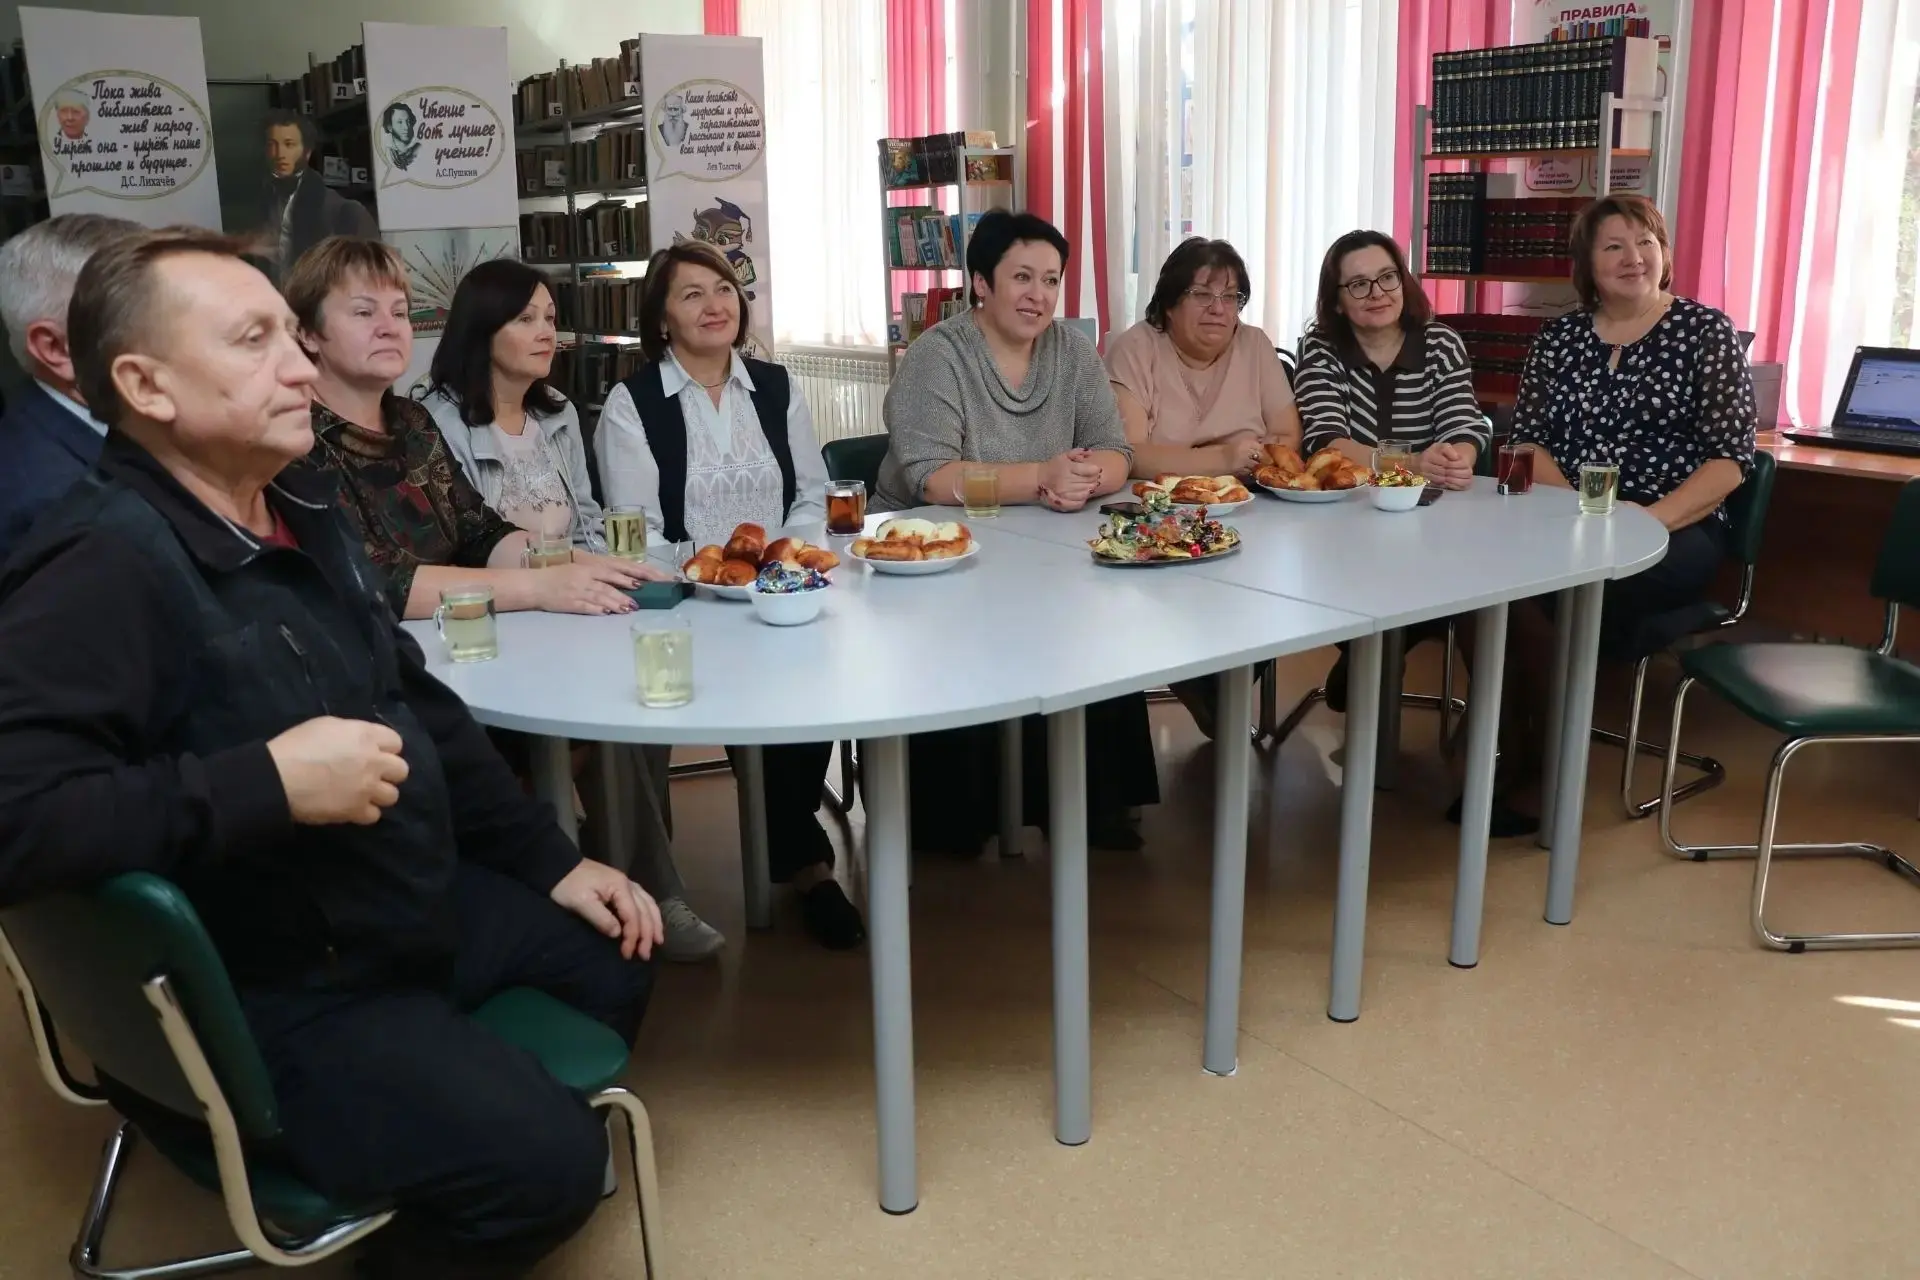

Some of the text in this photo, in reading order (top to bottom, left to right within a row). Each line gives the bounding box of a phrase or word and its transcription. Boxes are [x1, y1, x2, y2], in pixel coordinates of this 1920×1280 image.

[1560, 2, 1637, 21] ПРАВИЛА
[92, 80, 161, 100] Пока жива
[629, 85, 638, 95] А
[685, 89, 738, 104] Какое богатство
[98, 101, 172, 118] библиотека
[419, 97, 465, 119] Чтение
[553, 106, 562, 115] Б
[691, 105, 724, 120] мудрости
[734, 102, 753, 118] добра
[120, 119, 148, 134] жив
[417, 122, 496, 144] вот лучшее
[699, 118, 760, 132] заразительного
[688, 132, 725, 145] рассыпано
[737, 130, 761, 139] книгам
[54, 137, 92, 160] Умрёт
[97, 142, 118, 154] она
[133, 136, 169, 157] умрёт
[173, 138, 201, 150] наше
[435, 138, 493, 165] учение!
[680, 144, 694, 155] всех
[697, 141, 725, 157] народов
[71, 155, 192, 177] прошлое и будущее.
[707, 162, 742, 171] Лев Толстой
[121, 176, 176, 188] Д.С. Лихачёв
[611, 242, 618, 252] Е
